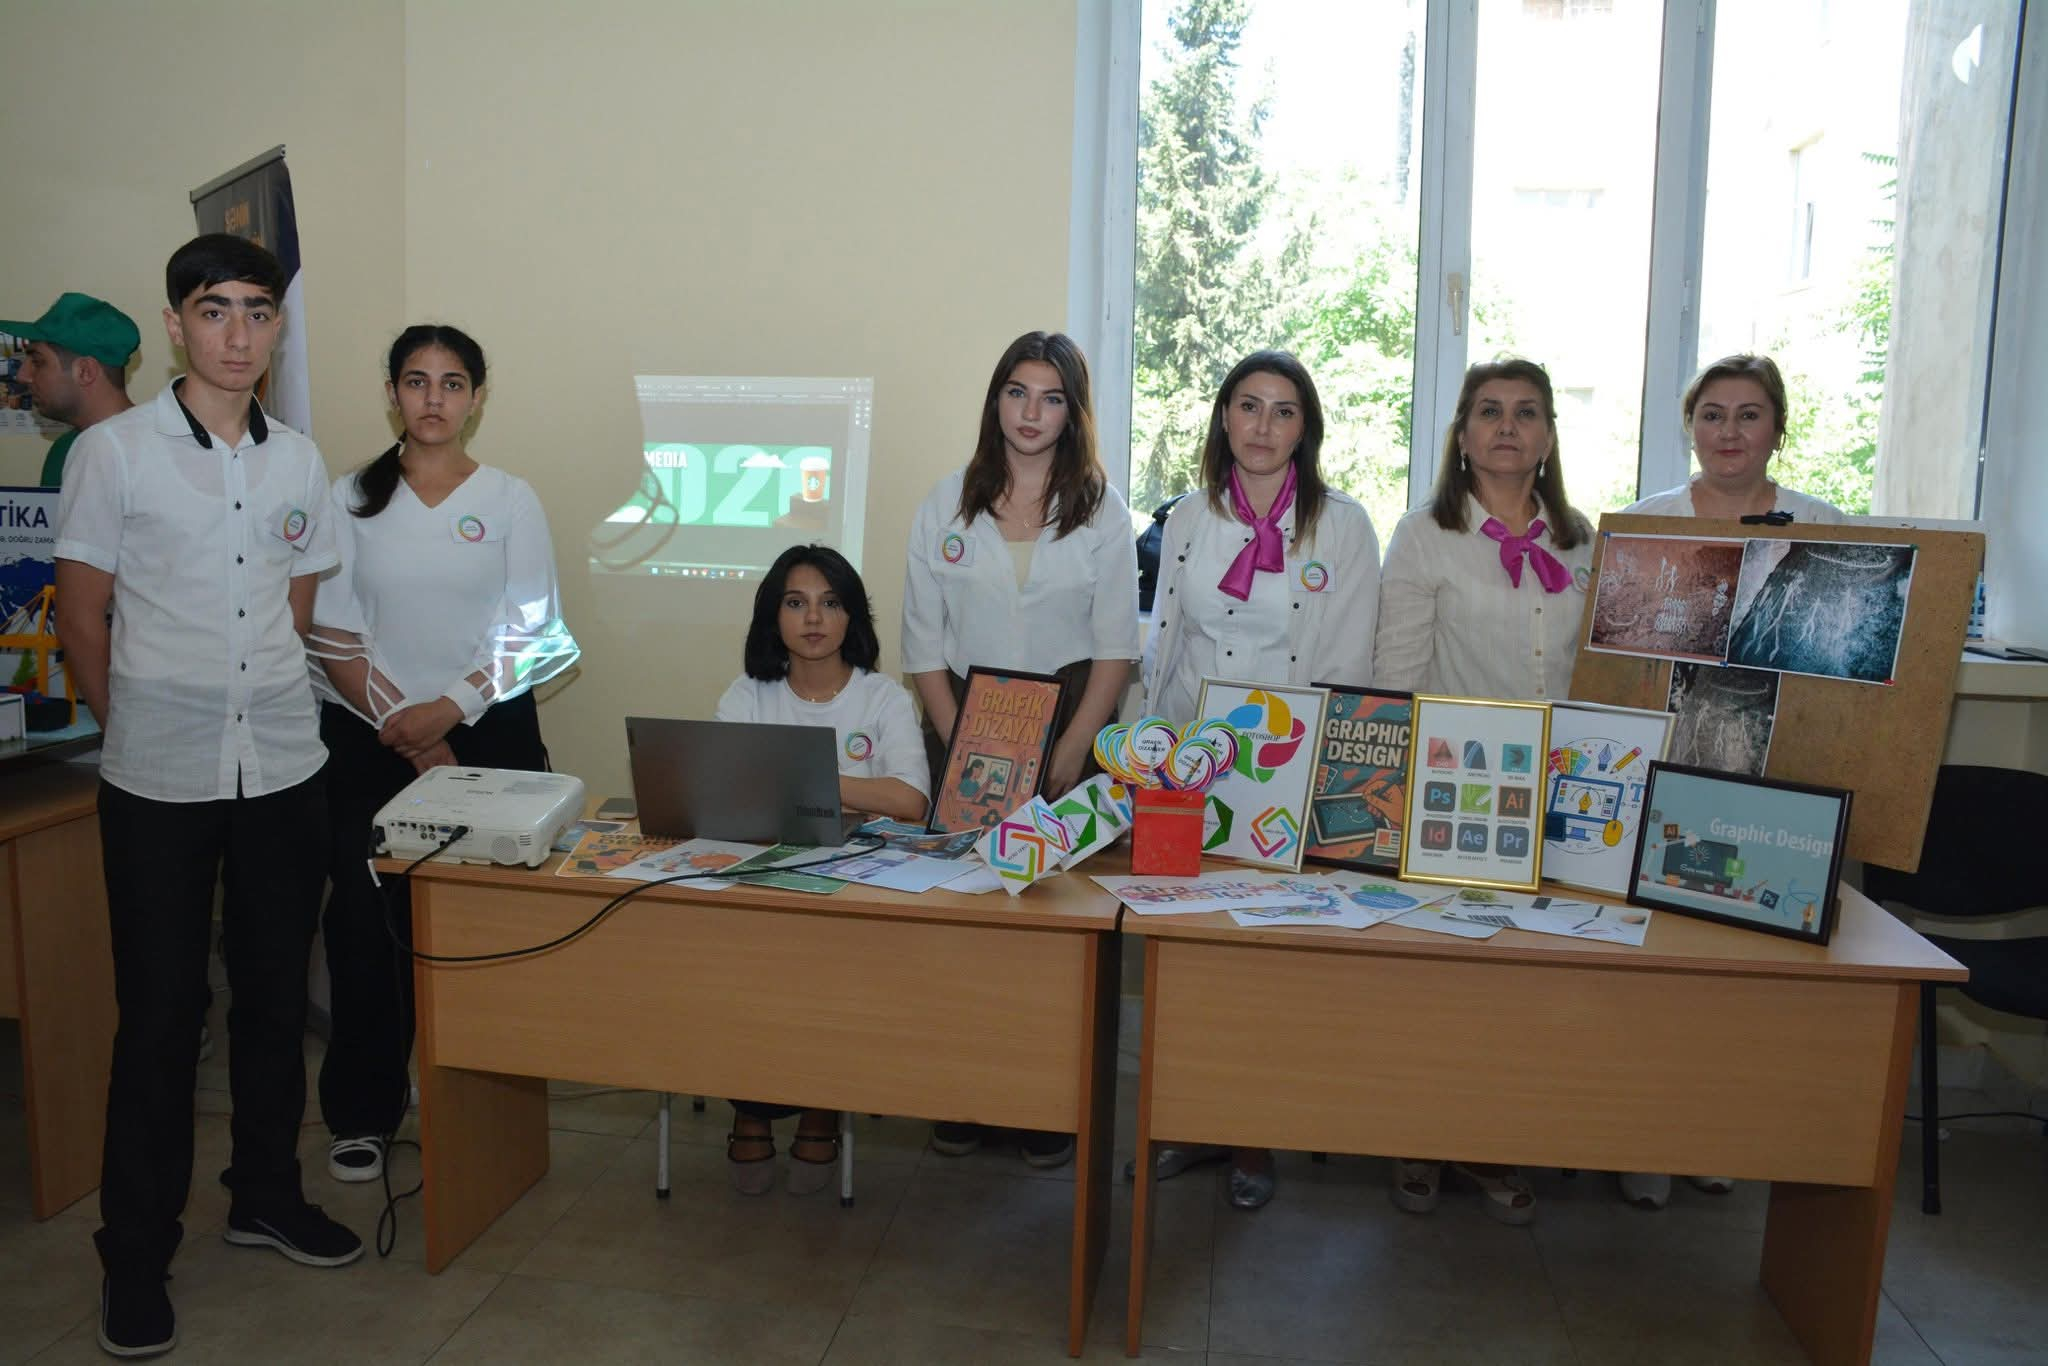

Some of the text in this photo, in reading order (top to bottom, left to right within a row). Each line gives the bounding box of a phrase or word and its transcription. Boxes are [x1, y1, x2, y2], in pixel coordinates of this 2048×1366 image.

[644, 451, 687, 467] MEDIA
[34, 536, 56, 544] ZAMA
[980, 688, 1048, 720] GRAFİK
[971, 716, 1041, 745] DİZAYN
[1326, 718, 1411, 746] GRAPHIC
[1327, 740, 1403, 768] DESIGN
[1430, 788, 1451, 805] Ps
[1505, 791, 1524, 809] Ai
[1428, 828, 1446, 844] Id
[1461, 829, 1484, 846] Ae
[1503, 832, 1524, 849] Pr
[1709, 817, 1834, 858] Graphic Design
